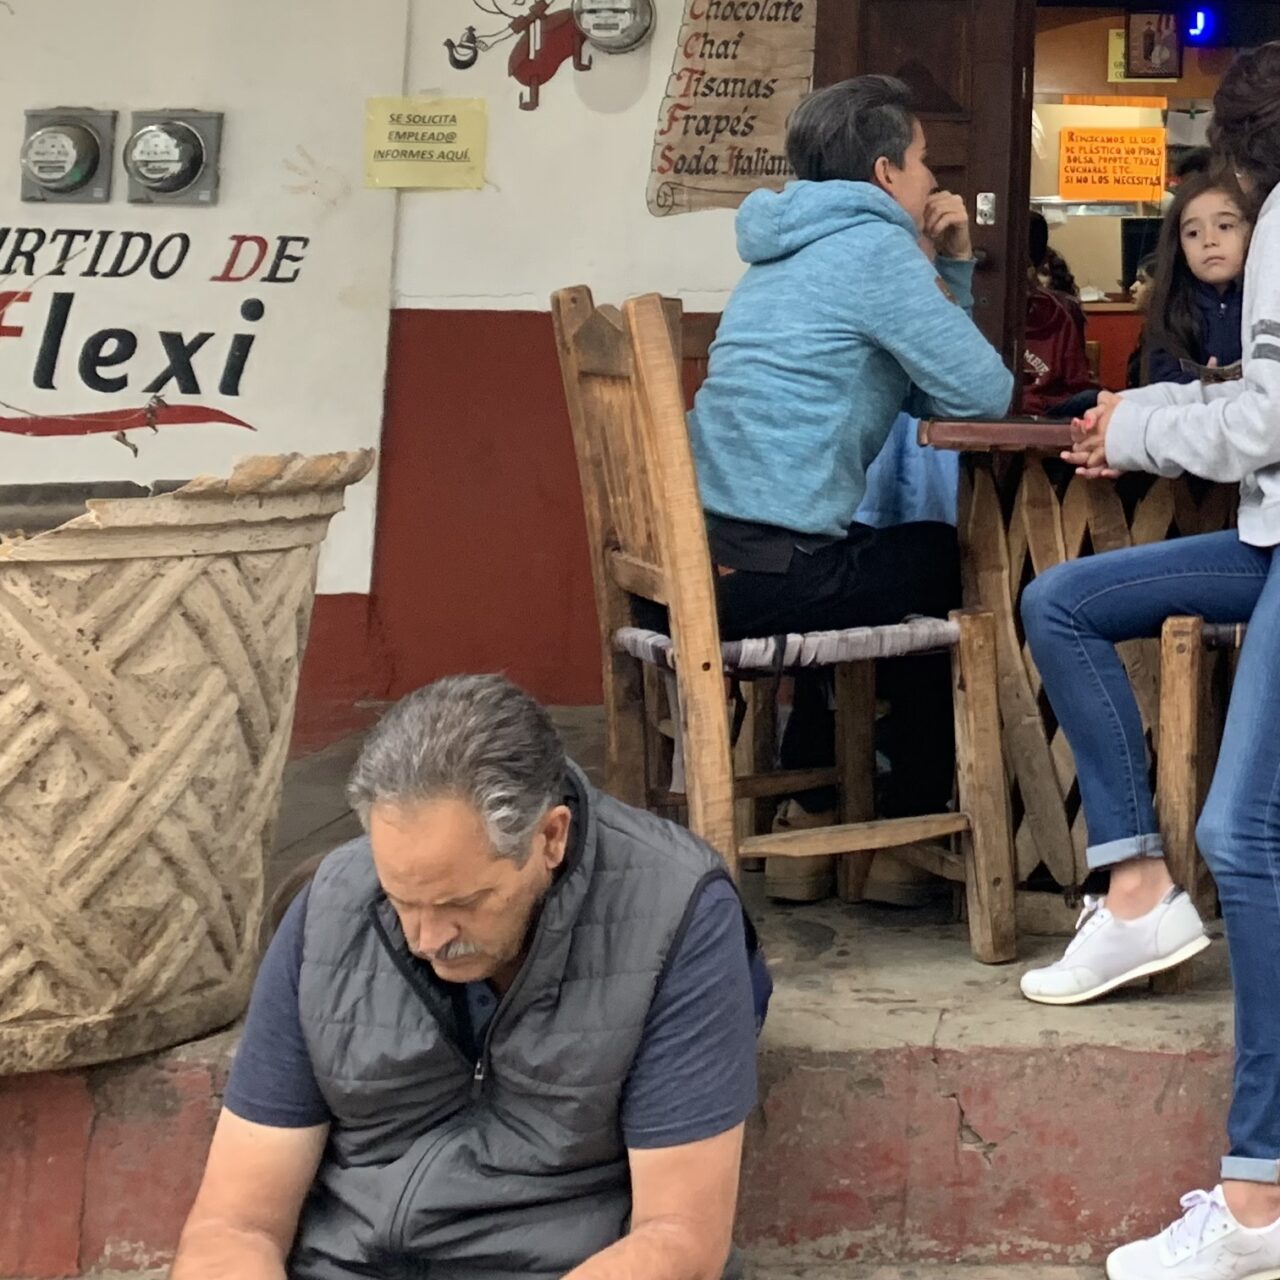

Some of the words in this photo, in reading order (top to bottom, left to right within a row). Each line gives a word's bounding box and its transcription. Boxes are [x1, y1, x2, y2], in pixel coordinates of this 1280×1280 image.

[682, 30, 745, 61] Chai
[675, 66, 780, 100] Tisanas
[388, 113, 403, 124] SE
[405, 113, 458, 125] SOLICITA
[658, 102, 759, 145] Frapés
[387, 130, 458, 143] EMPLEAD@
[373, 148, 434, 161] INFORMES
[656, 144, 720, 176] Soda
[1091, 175, 1110, 185] LOS
[209, 233, 311, 284] DE
